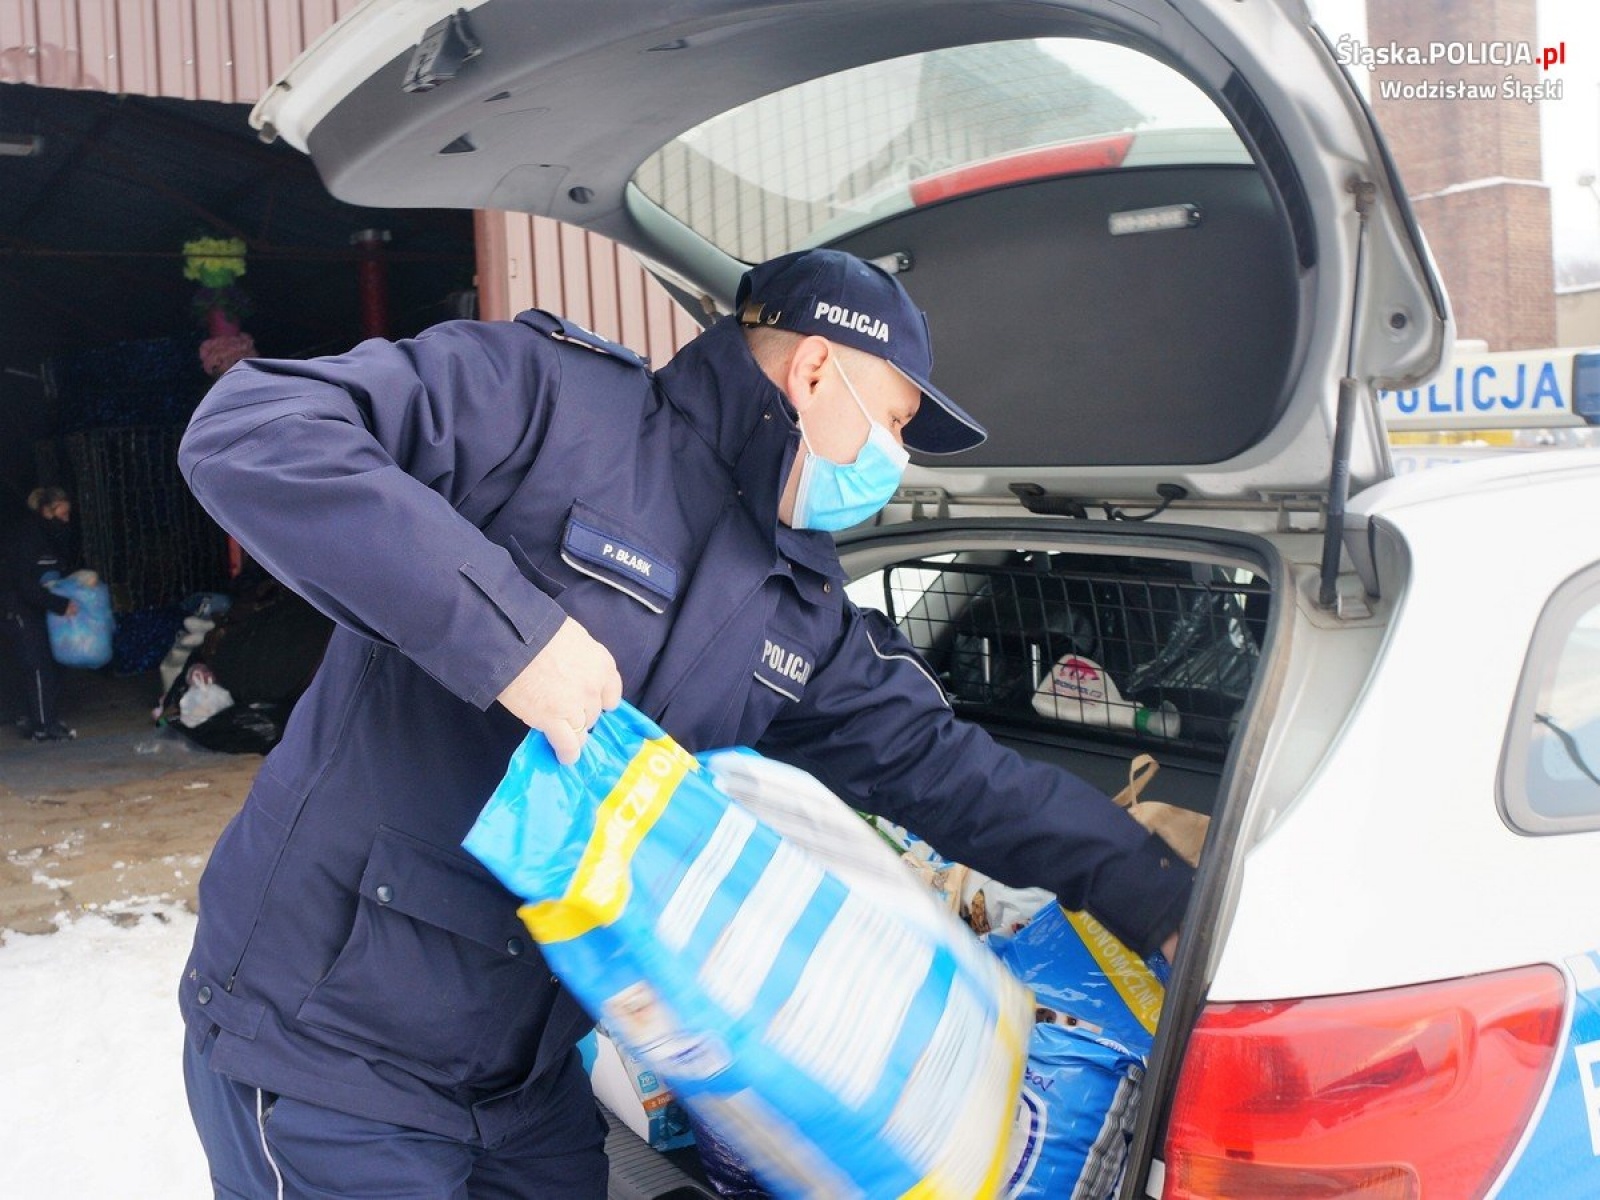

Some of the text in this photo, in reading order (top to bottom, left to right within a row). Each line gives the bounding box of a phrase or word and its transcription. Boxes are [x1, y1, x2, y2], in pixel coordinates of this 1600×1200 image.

[814, 301, 889, 343] POLICJA
[1378, 361, 1565, 414] OLICJA
[602, 543, 615, 558] P.
[1080, 909, 1158, 1012] KONOMICZNE
